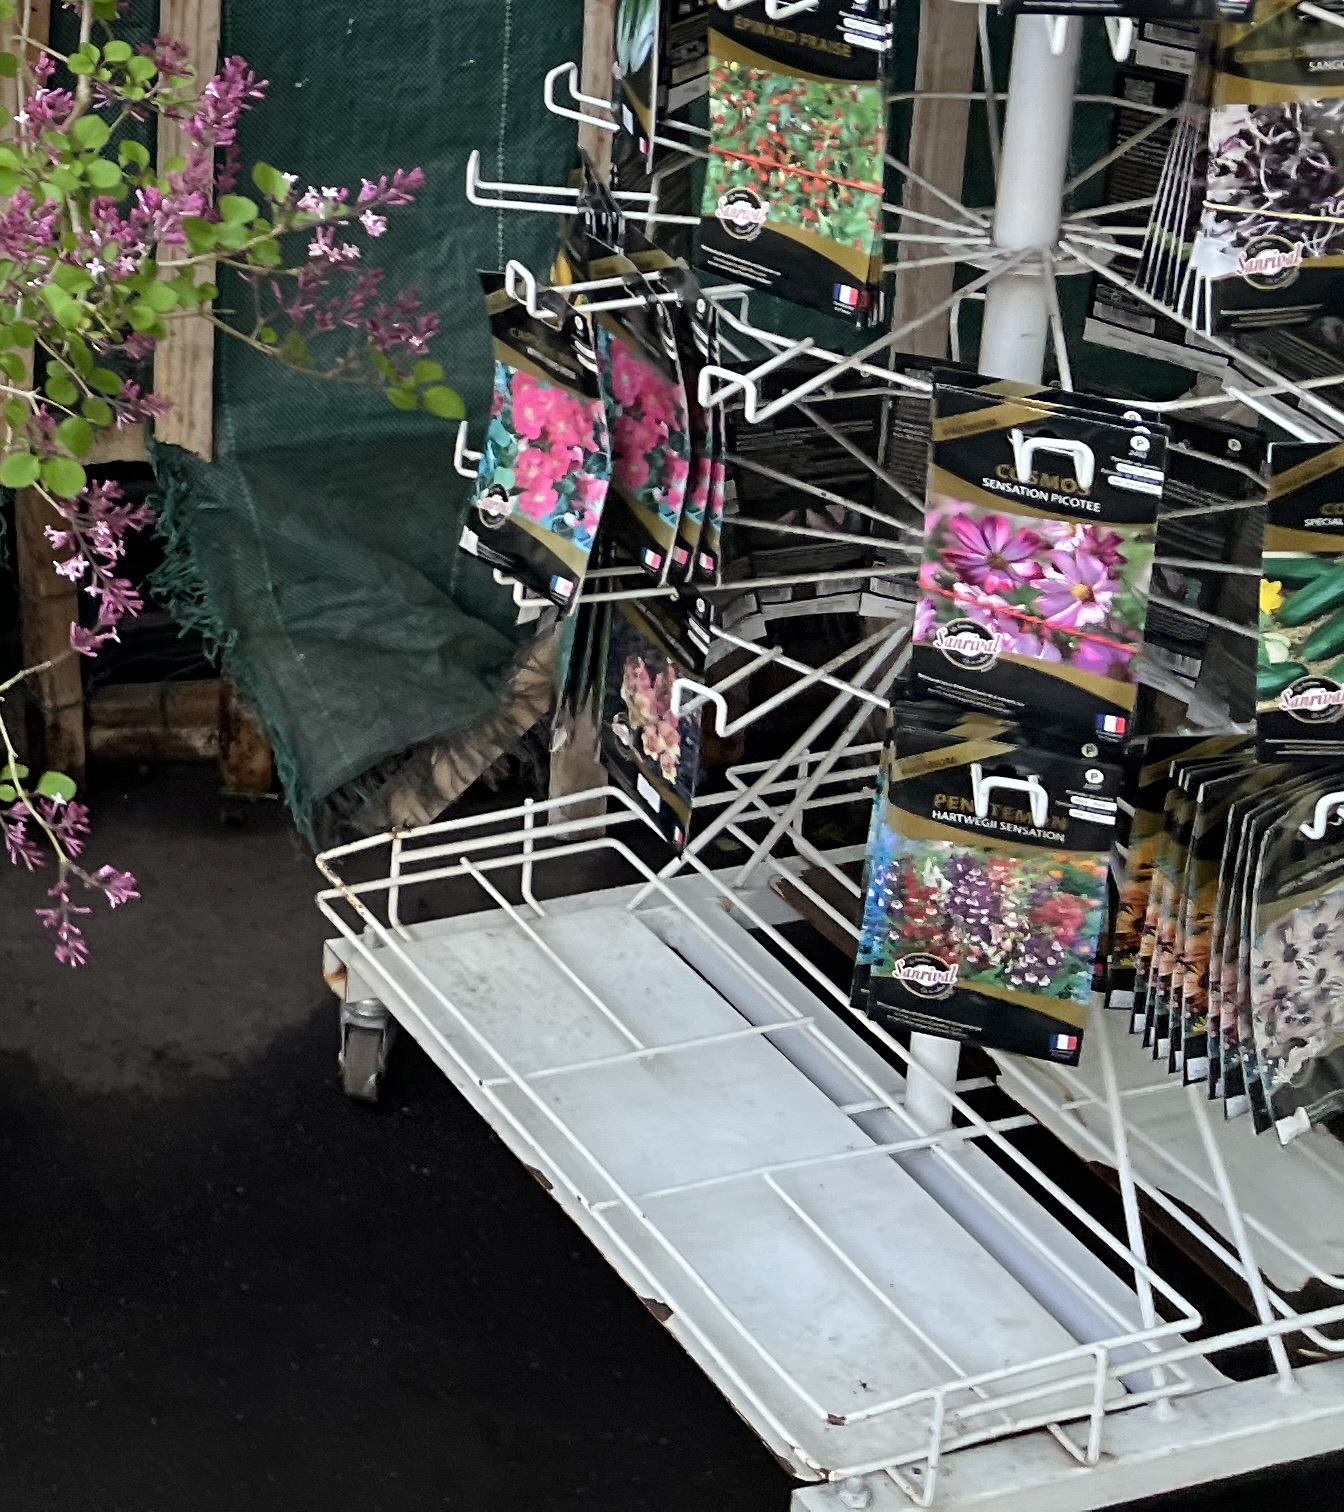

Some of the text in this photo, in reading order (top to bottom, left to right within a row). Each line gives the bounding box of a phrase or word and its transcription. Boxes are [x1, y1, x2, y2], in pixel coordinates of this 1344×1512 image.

[982, 476, 1102, 514] SENSATION PICOTEE
[934, 626, 1002, 658] Sanrival
[931, 809, 1066, 843] HARTWEGII SENSATION
[933, 792, 1070, 831] PENTEMN
[893, 956, 960, 988] Sanrival
